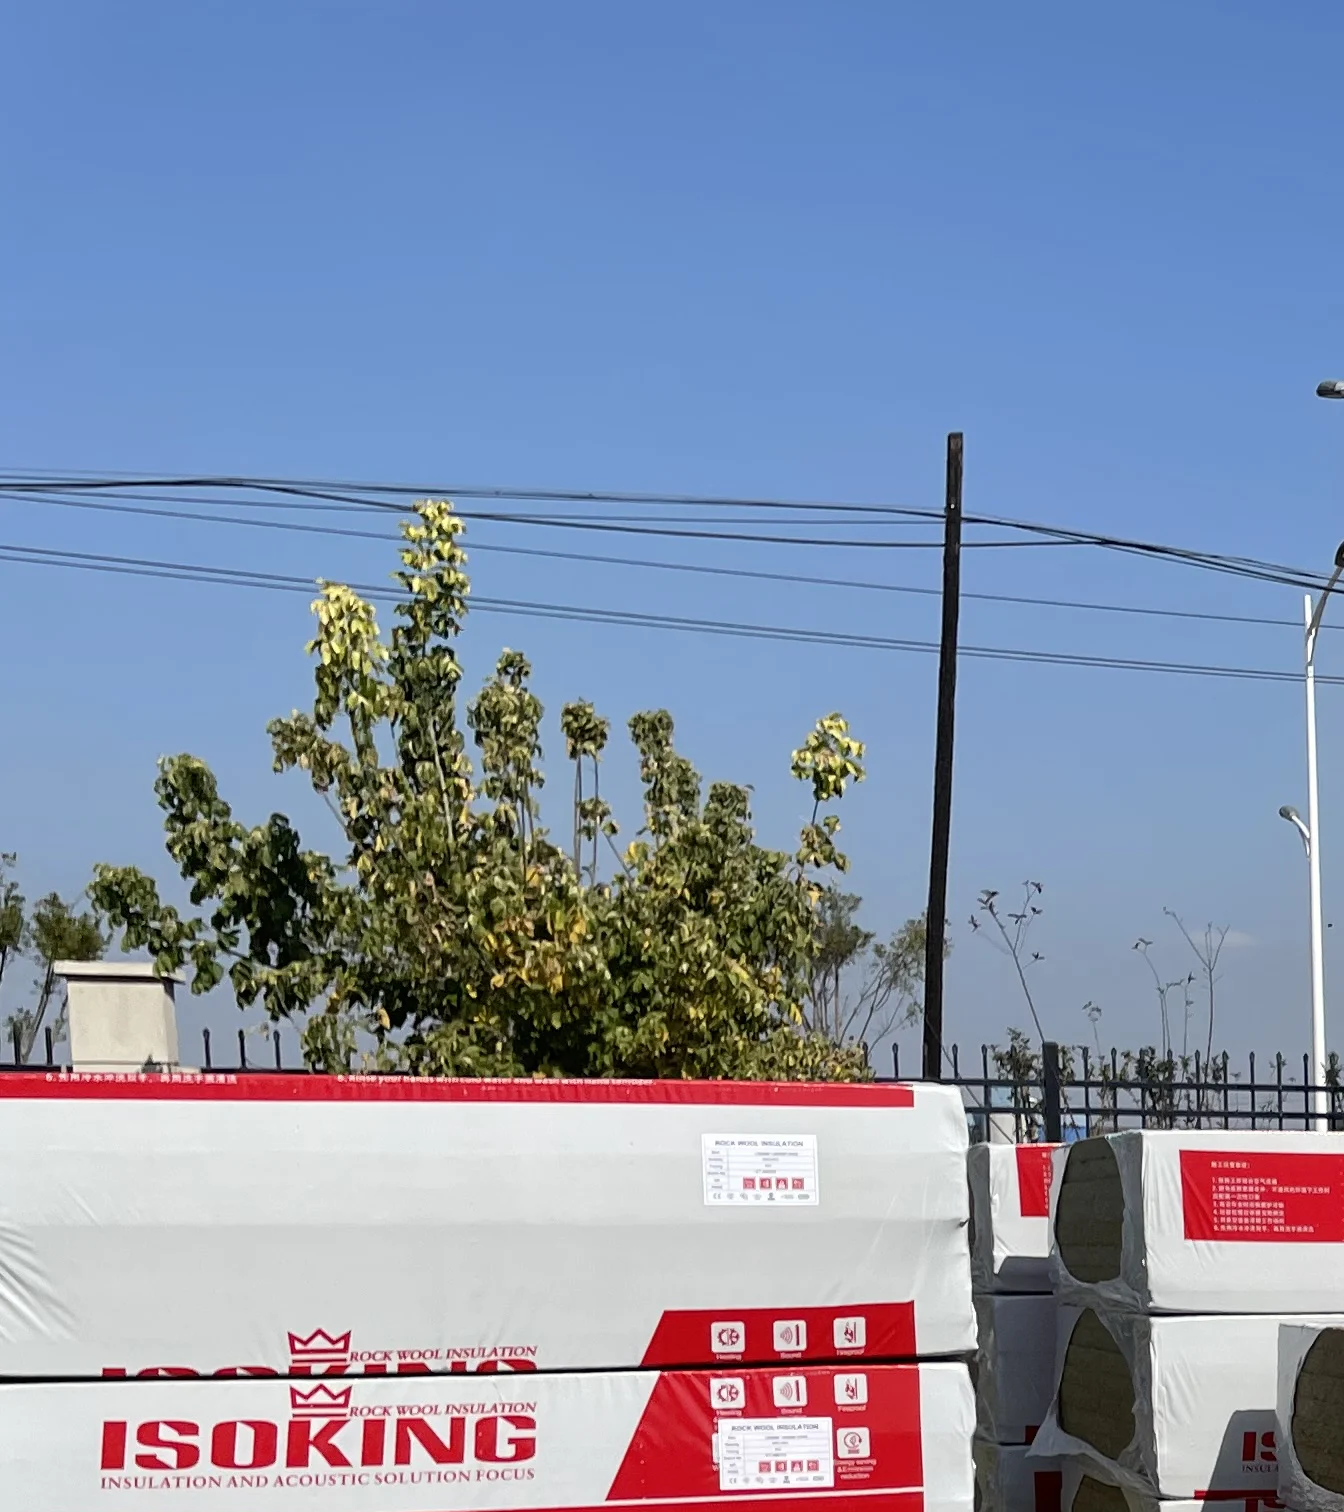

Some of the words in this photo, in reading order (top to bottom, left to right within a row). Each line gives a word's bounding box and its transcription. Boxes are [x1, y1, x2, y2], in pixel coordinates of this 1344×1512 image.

[349, 1350, 392, 1362] ROCK
[397, 1349, 441, 1360] WOOL
[446, 1346, 537, 1359] INSULATION
[349, 1405, 392, 1417] ROCK
[396, 1404, 441, 1416] WOOL
[445, 1402, 536, 1415] INSULATION
[100, 1415, 537, 1471] ISOKING
[101, 1476, 221, 1489] INSULATION
[227, 1475, 268, 1488] AND
[273, 1473, 370, 1487] ACOUSTIC
[374, 1471, 470, 1484] SOLUTION
[476, 1468, 534, 1481] FOCUS
